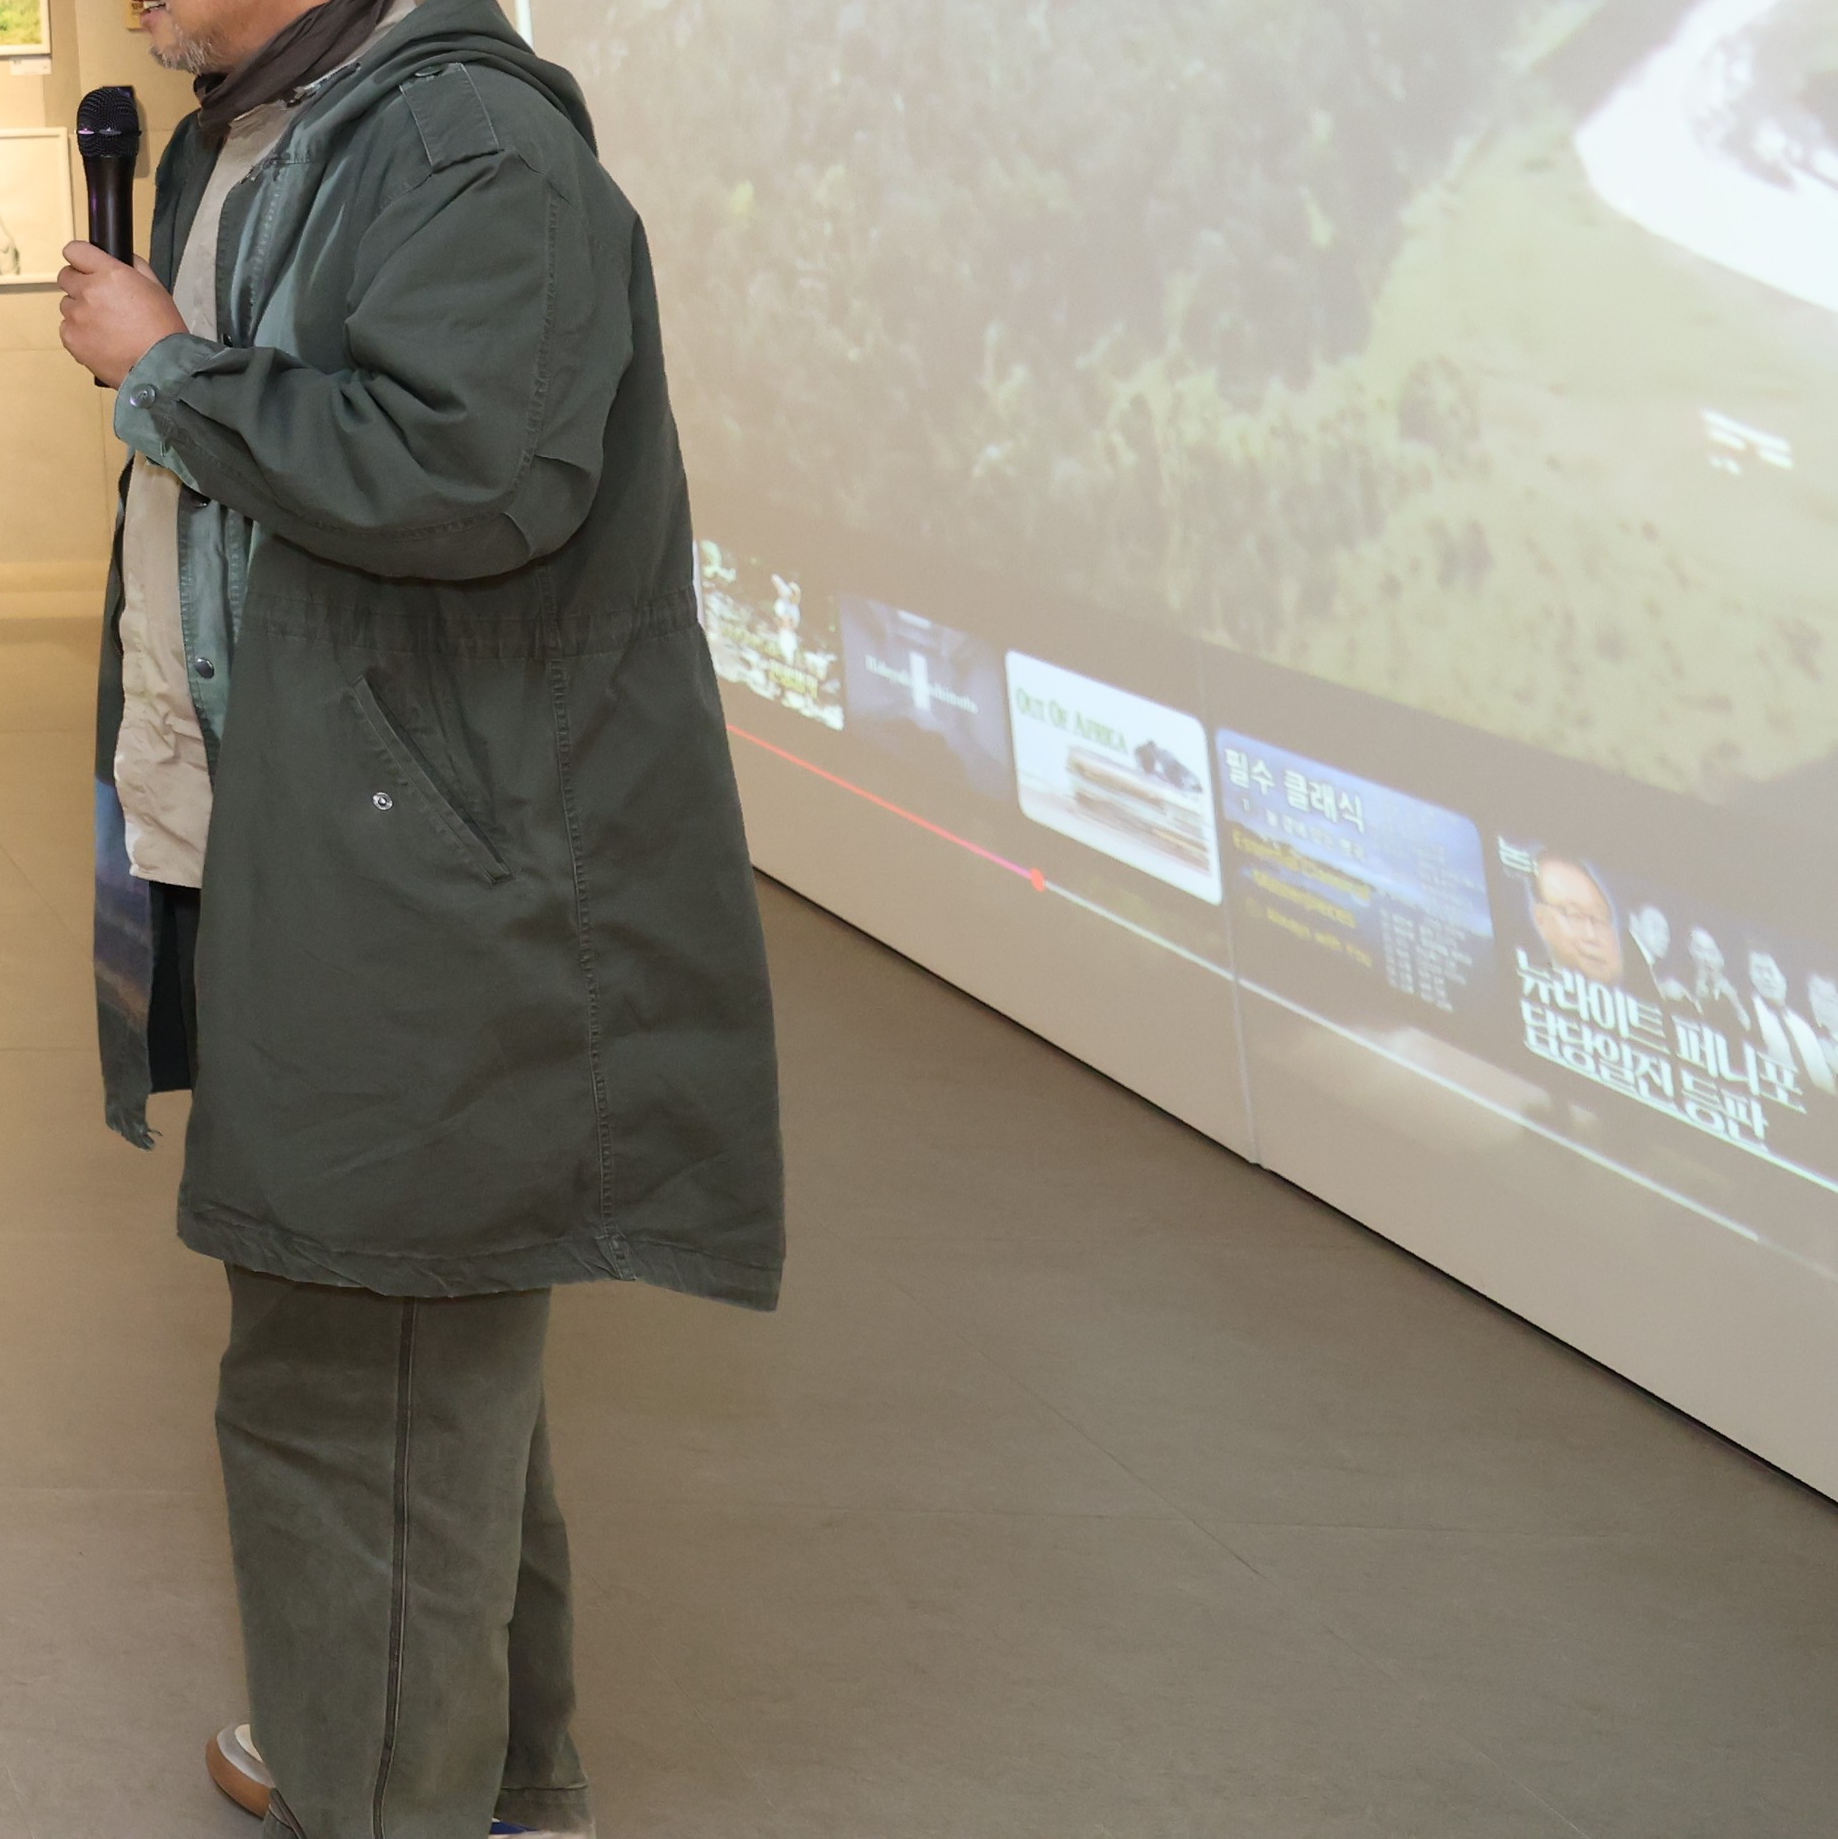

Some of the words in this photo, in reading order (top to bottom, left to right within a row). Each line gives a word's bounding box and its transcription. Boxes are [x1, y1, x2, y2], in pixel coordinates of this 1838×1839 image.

[1224, 747, 1275, 796] 필수
[1283, 768, 1365, 835] 클래식
[1515, 946, 1671, 1058] 뉴라이트
[1519, 998, 1677, 1109] 담당일진
[1679, 1068, 1770, 1153] 등판
